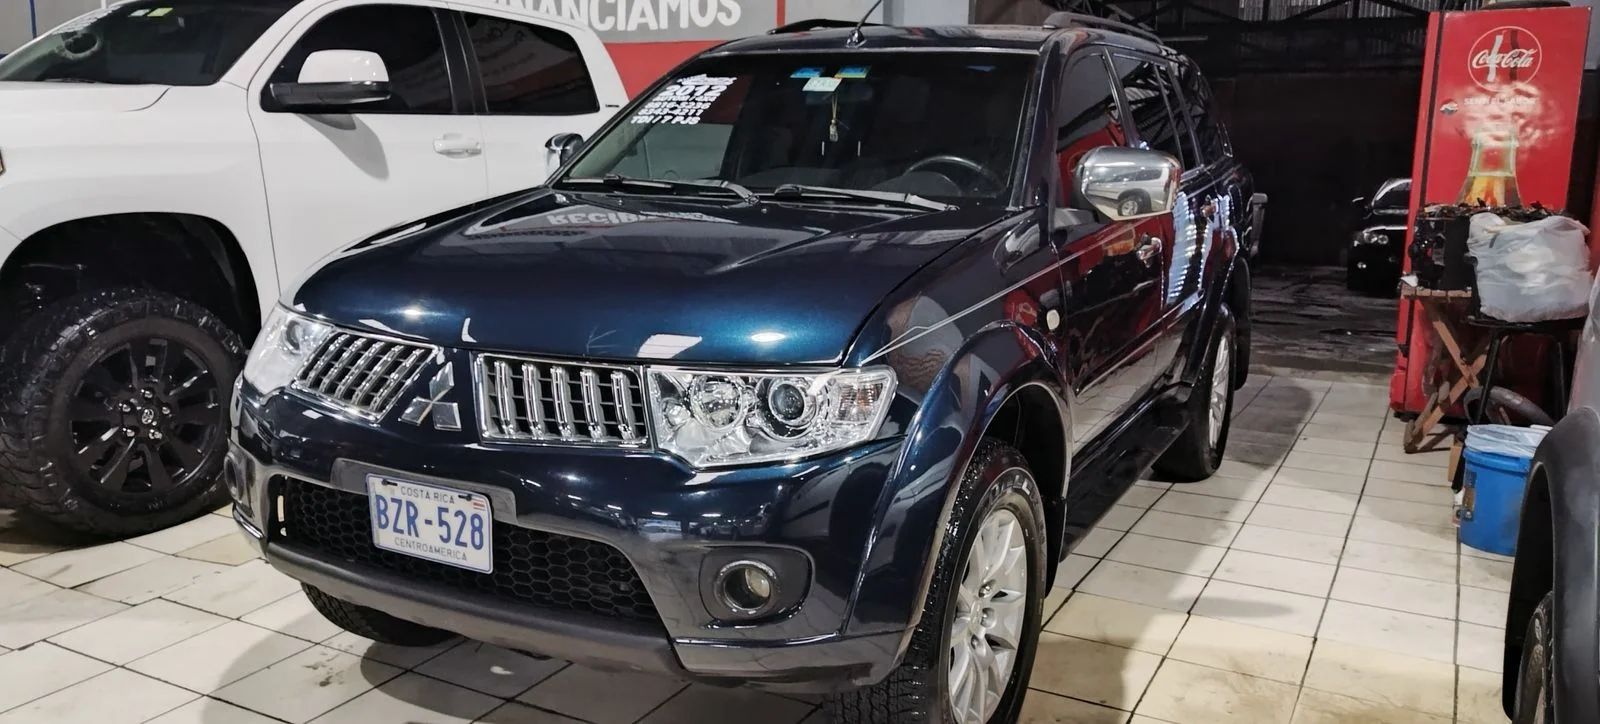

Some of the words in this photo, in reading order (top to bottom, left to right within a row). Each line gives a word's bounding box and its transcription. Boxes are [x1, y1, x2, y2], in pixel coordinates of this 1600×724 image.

[661, 84, 728, 96] 2012
[400, 486, 431, 500] COSTA
[433, 493, 455, 504] RICA
[375, 495, 484, 550] BZR-528
[394, 537, 468, 561] CENTROAMERICA
